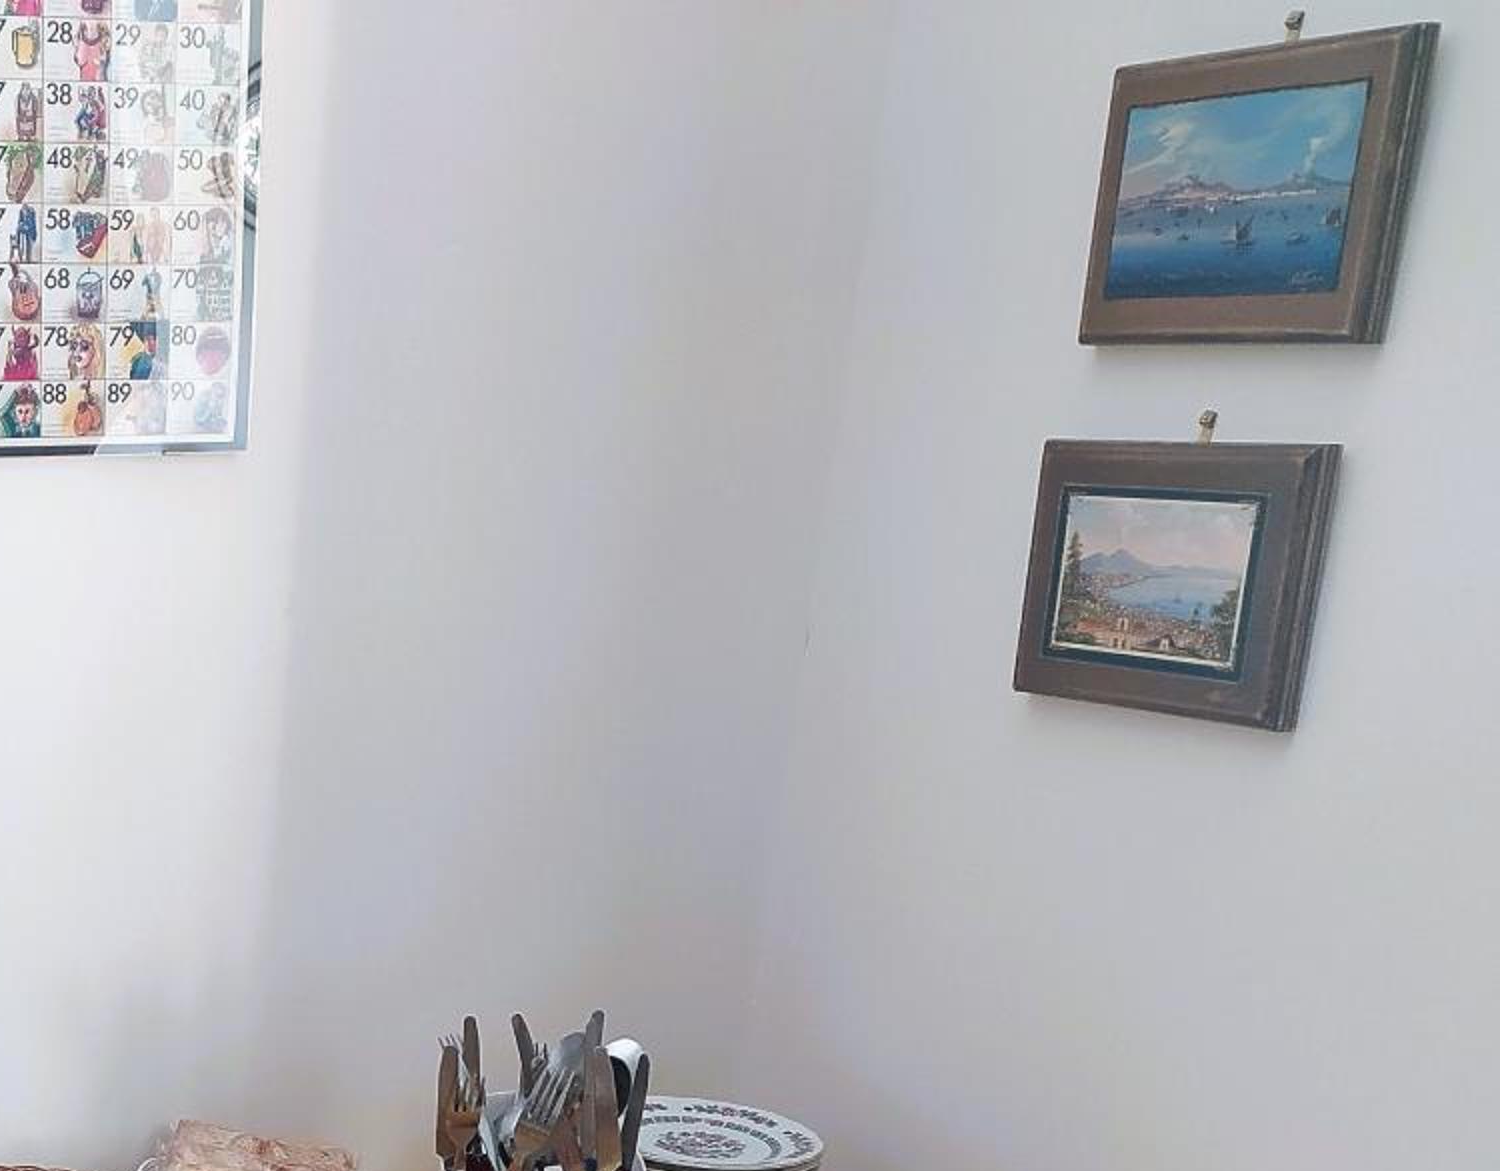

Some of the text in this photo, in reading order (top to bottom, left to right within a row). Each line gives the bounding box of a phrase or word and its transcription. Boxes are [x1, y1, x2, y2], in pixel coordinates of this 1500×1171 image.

[47, 21, 72, 43] 28
[116, 24, 141, 46] 29
[180, 27, 205, 48] 30
[47, 83, 72, 105] 38
[114, 88, 138, 109] 39
[180, 90, 205, 111] 40
[47, 147, 72, 169] 48
[113, 148, 138, 170] 49
[178, 150, 202, 171] 50
[46, 209, 71, 231] 58
[110, 209, 135, 231] 59
[174, 210, 199, 231] 60
[45, 268, 70, 289] 68
[110, 269, 135, 289] 69
[173, 270, 196, 289] 70
[44, 326, 69, 346] 78
[110, 326, 133, 346] 79
[172, 325, 195, 344] 80
[44, 384, 67, 404] 88
[109, 383, 132, 403] 89
[172, 382, 195, 401] 90
